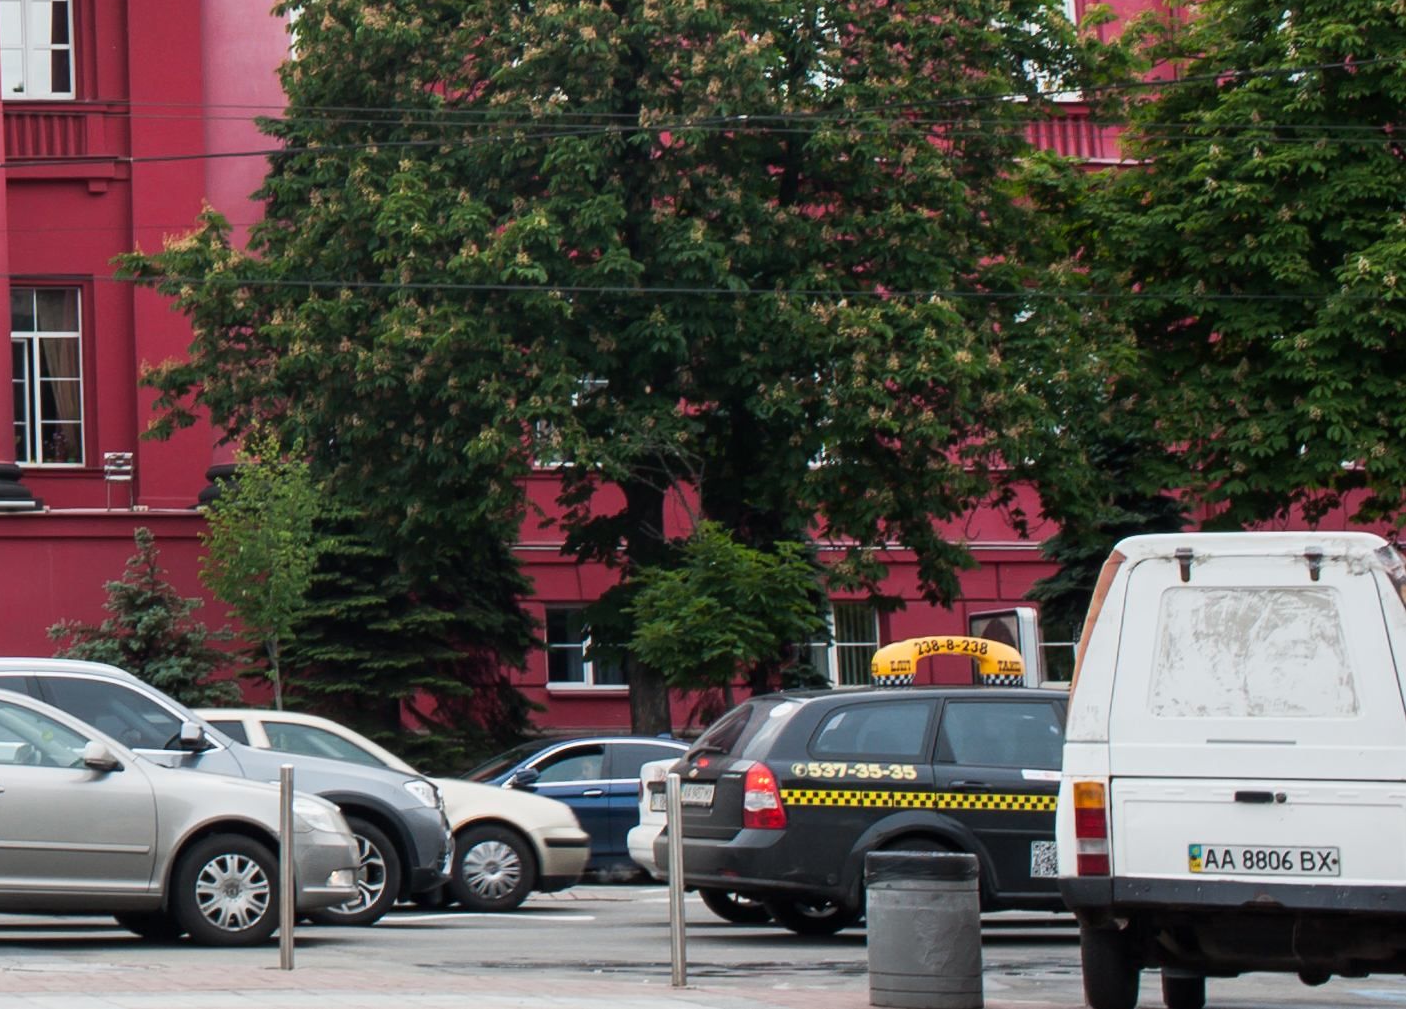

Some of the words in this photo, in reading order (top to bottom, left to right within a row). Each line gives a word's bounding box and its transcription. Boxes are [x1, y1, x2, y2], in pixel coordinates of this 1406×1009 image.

[914, 639, 988, 655] 238-8-238
[808, 762, 917, 780] 537-35-35
[1204, 848, 1236, 870] AA
[1242, 849, 1294, 871] 8806
[1300, 850, 1333, 872] BX
